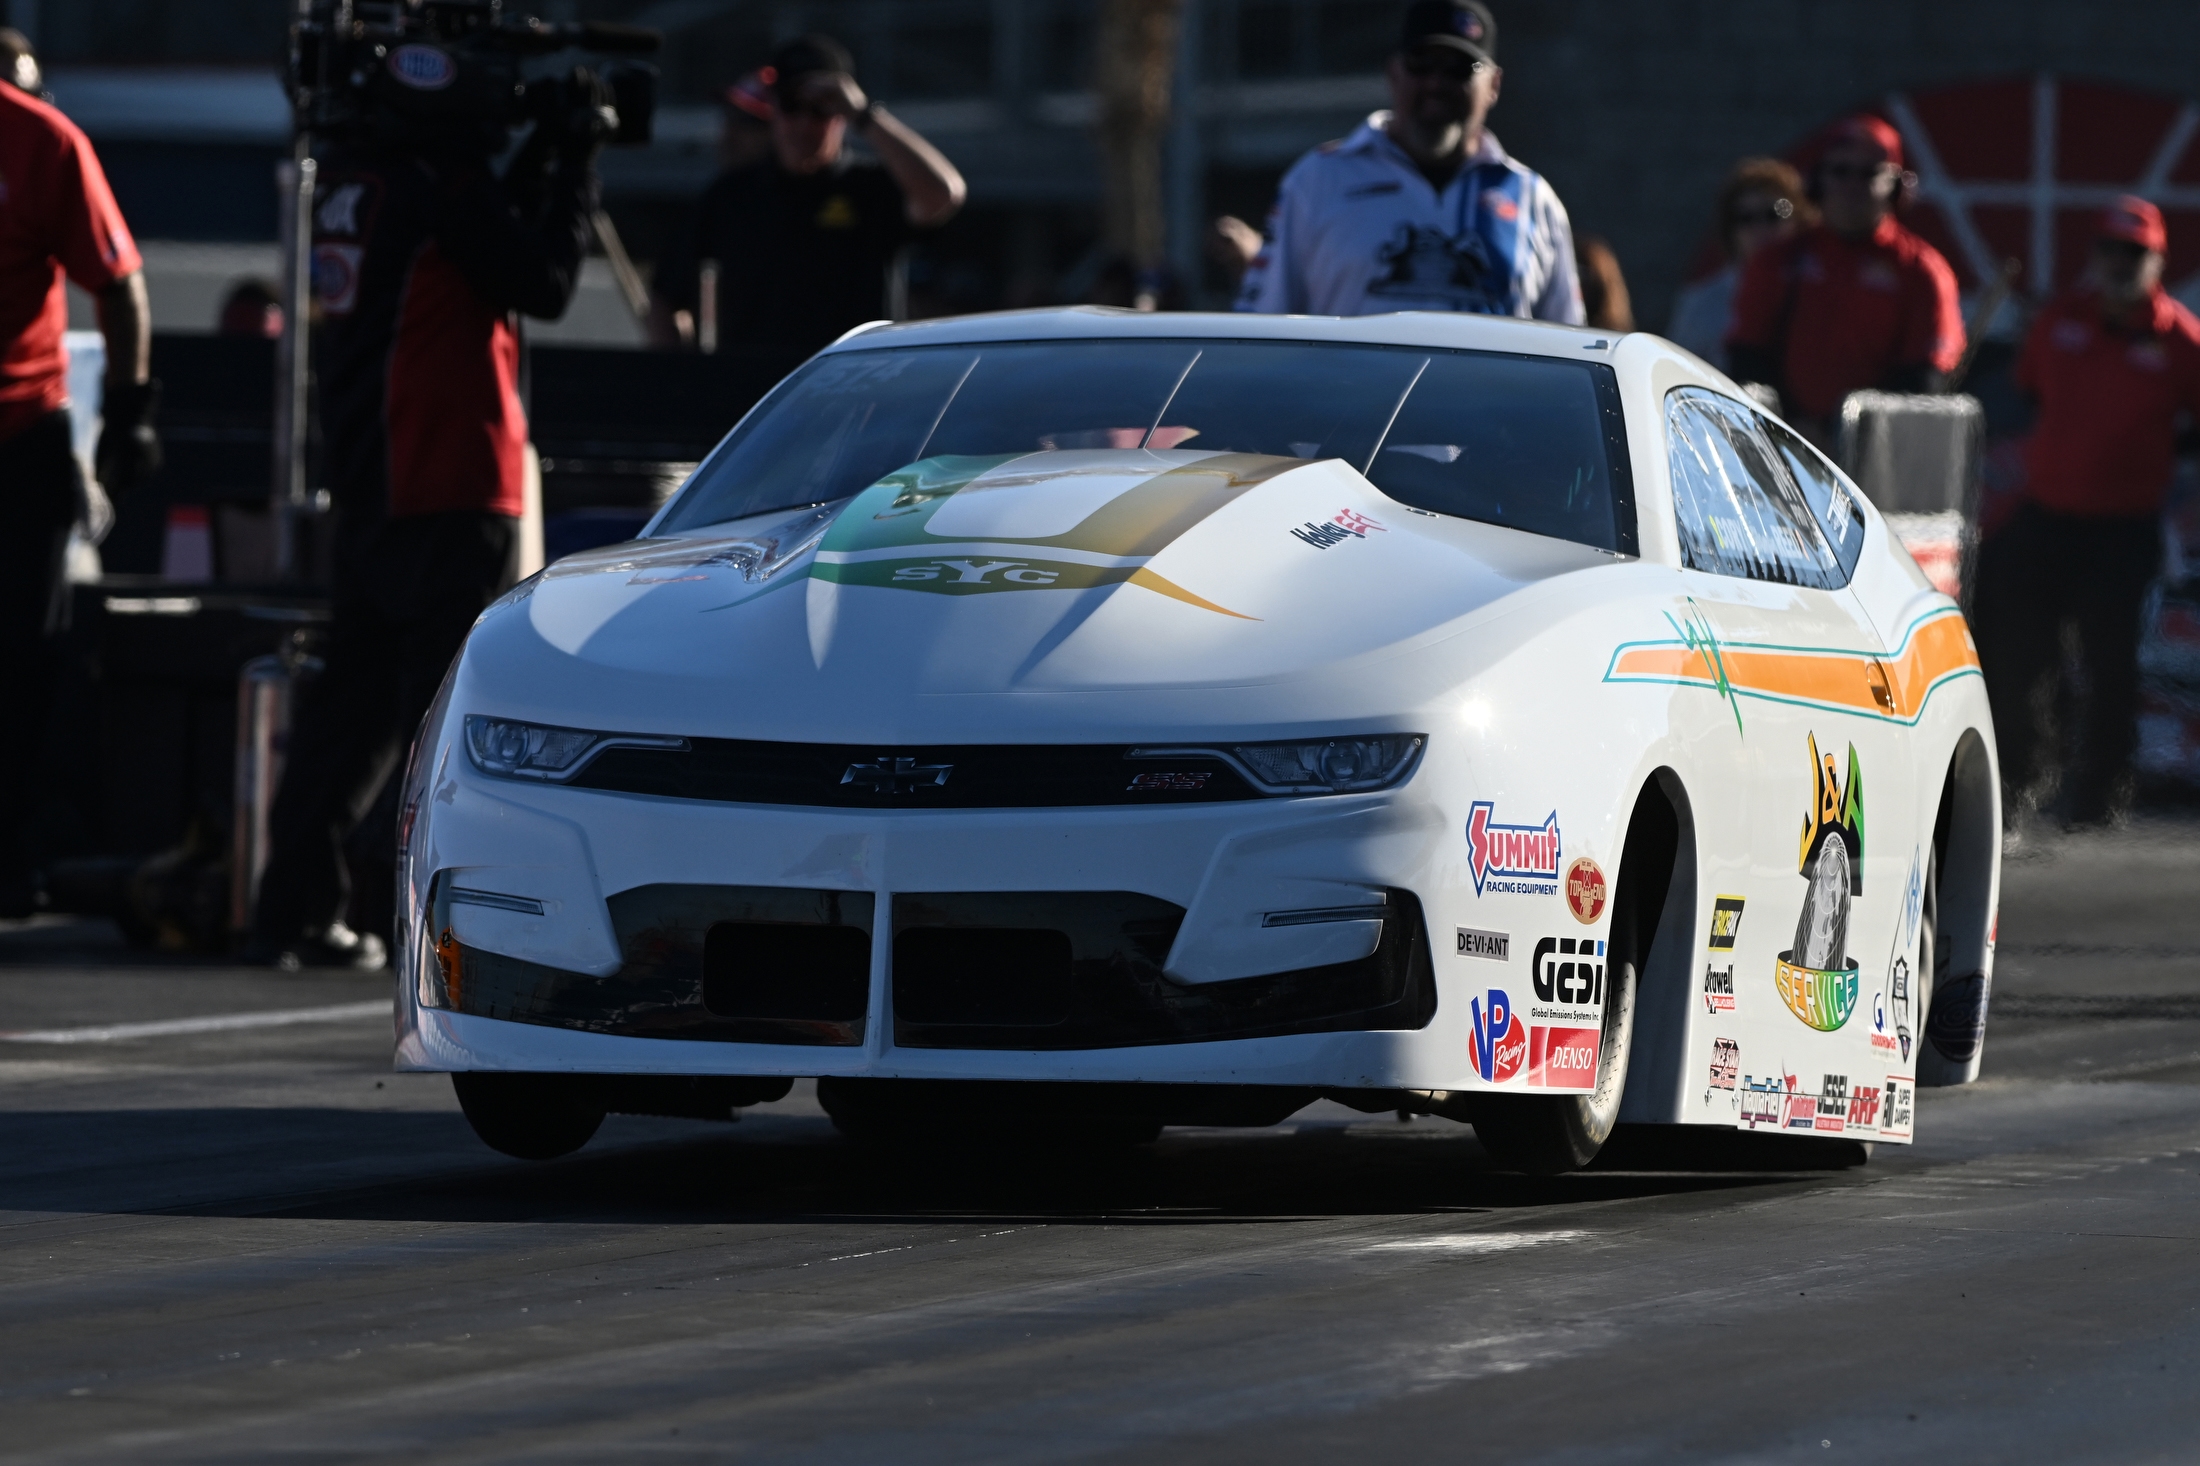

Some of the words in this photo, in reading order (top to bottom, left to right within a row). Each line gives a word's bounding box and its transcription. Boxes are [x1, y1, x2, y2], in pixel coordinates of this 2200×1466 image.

[1290, 521, 1366, 550] Holley
[1487, 881, 1516, 894] RACING
[1517, 883, 1558, 896] EQUIPMENT
[1570, 879, 1583, 897] TOP
[1779, 965, 1855, 1027] SERVICE
[1531, 1007, 1549, 1019] Global
[1549, 1009, 1573, 1020] Emissions
[1573, 1010, 1592, 1023] Systems
[1470, 988, 1511, 1083] VP
[1496, 1038, 1527, 1074] Racing
[1553, 1046, 1593, 1070] DENSO
[1847, 1086, 1880, 1125] ARP
